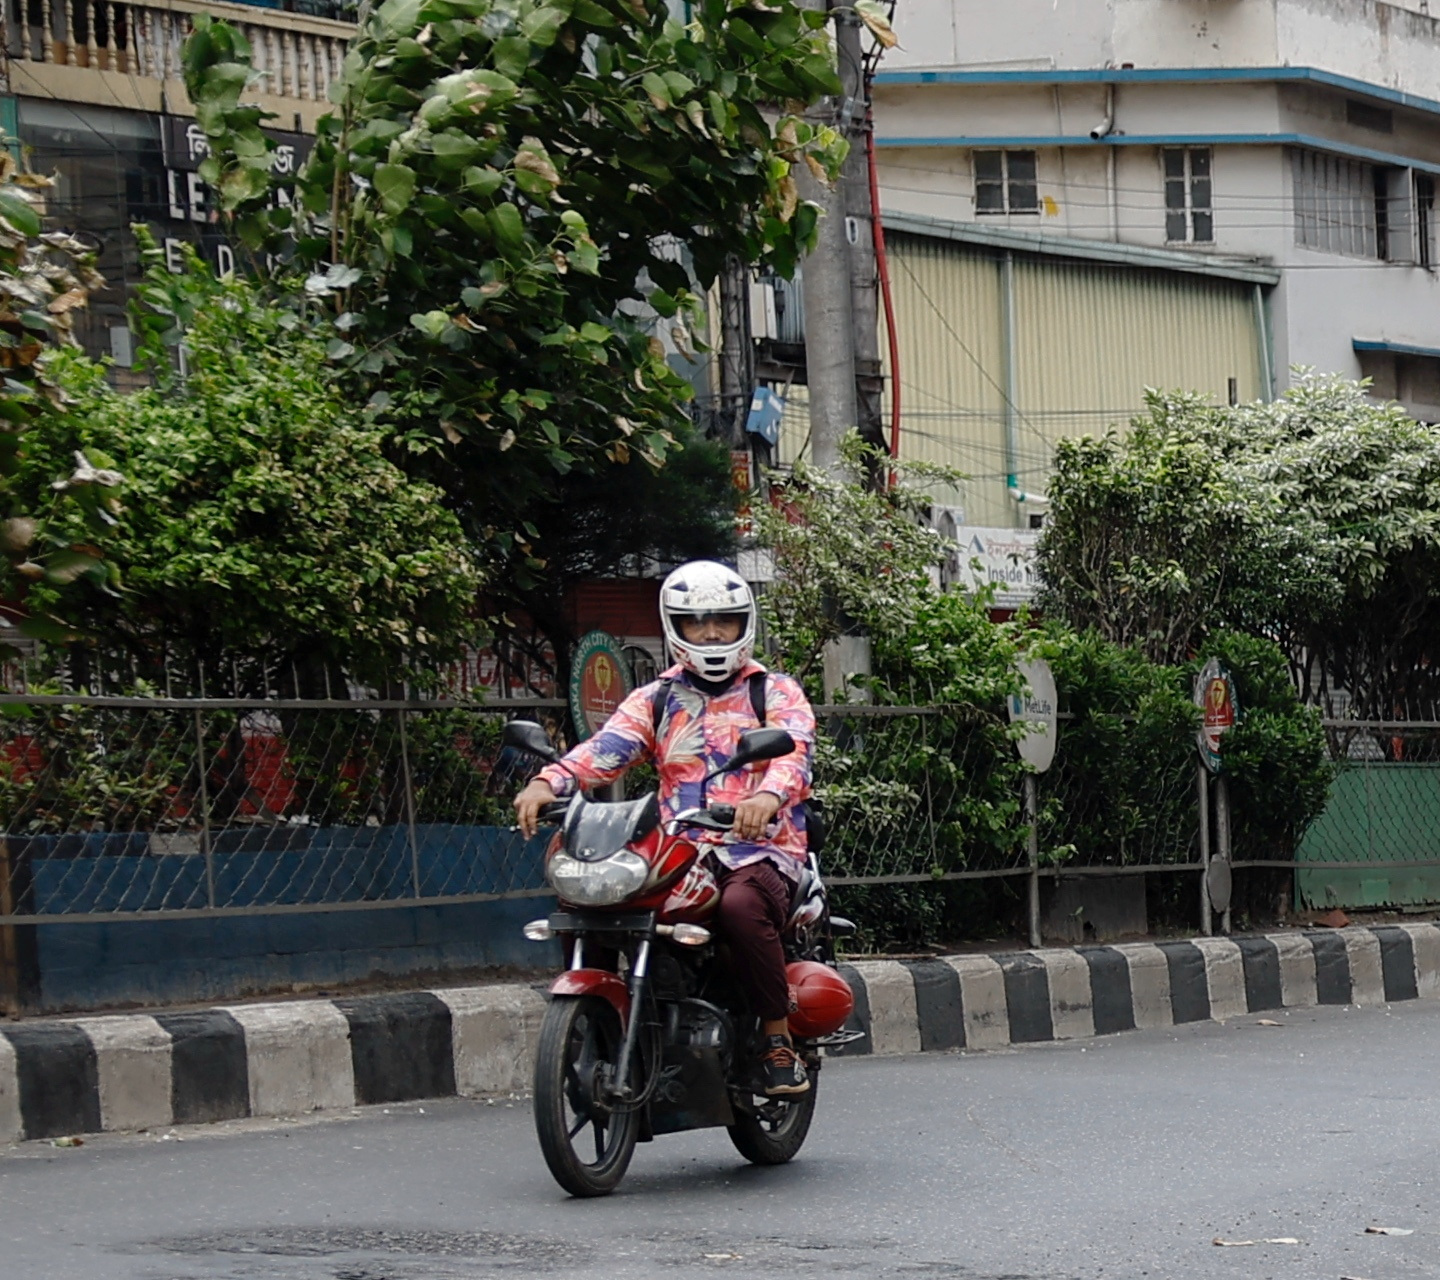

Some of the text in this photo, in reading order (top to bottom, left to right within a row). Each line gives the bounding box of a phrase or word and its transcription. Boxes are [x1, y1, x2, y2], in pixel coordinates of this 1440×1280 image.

[987, 564, 1023, 583] Inside
[573, 639, 592, 679] NORTH
[591, 632, 609, 648] CITY
[1025, 698, 1052, 715] MetLife
